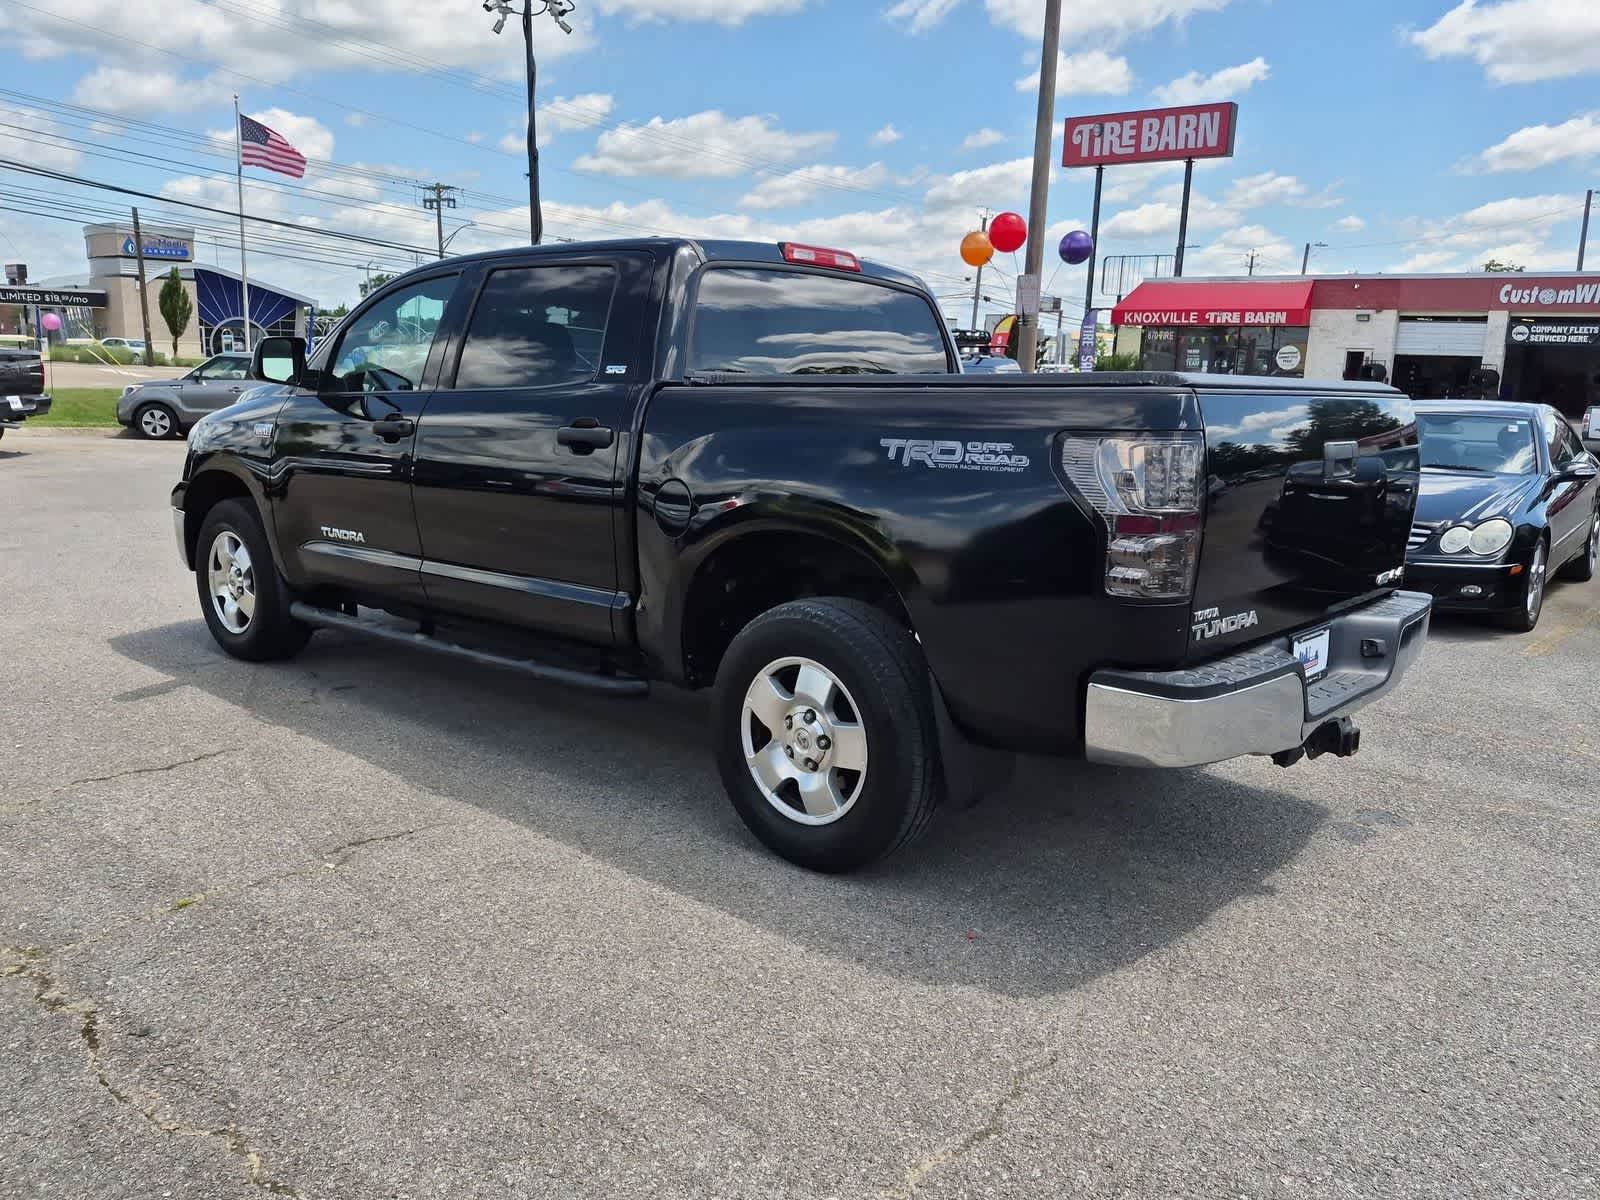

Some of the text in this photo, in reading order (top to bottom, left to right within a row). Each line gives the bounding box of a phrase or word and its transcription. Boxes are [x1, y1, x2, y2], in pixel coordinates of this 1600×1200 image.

[1140, 111, 1221, 153] BARN
[1124, 311, 1198, 324] KNOXVILLE
[1244, 311, 1287, 324] BARN
[1082, 325, 1094, 347] TIRE
[1530, 325, 1568, 334] COMPANY
[1569, 326, 1599, 334] FLEETS
[1529, 334, 1567, 342] SERVICED
[880, 438, 1015, 468] TRD OFF
[965, 452, 1030, 467] ROAD
[982, 465, 1025, 474] DEVELOPMENT
[321, 526, 366, 543] TUNDRA
[1194, 607, 1220, 622] TOYOTA
[1192, 610, 1258, 641] TUNDRA
